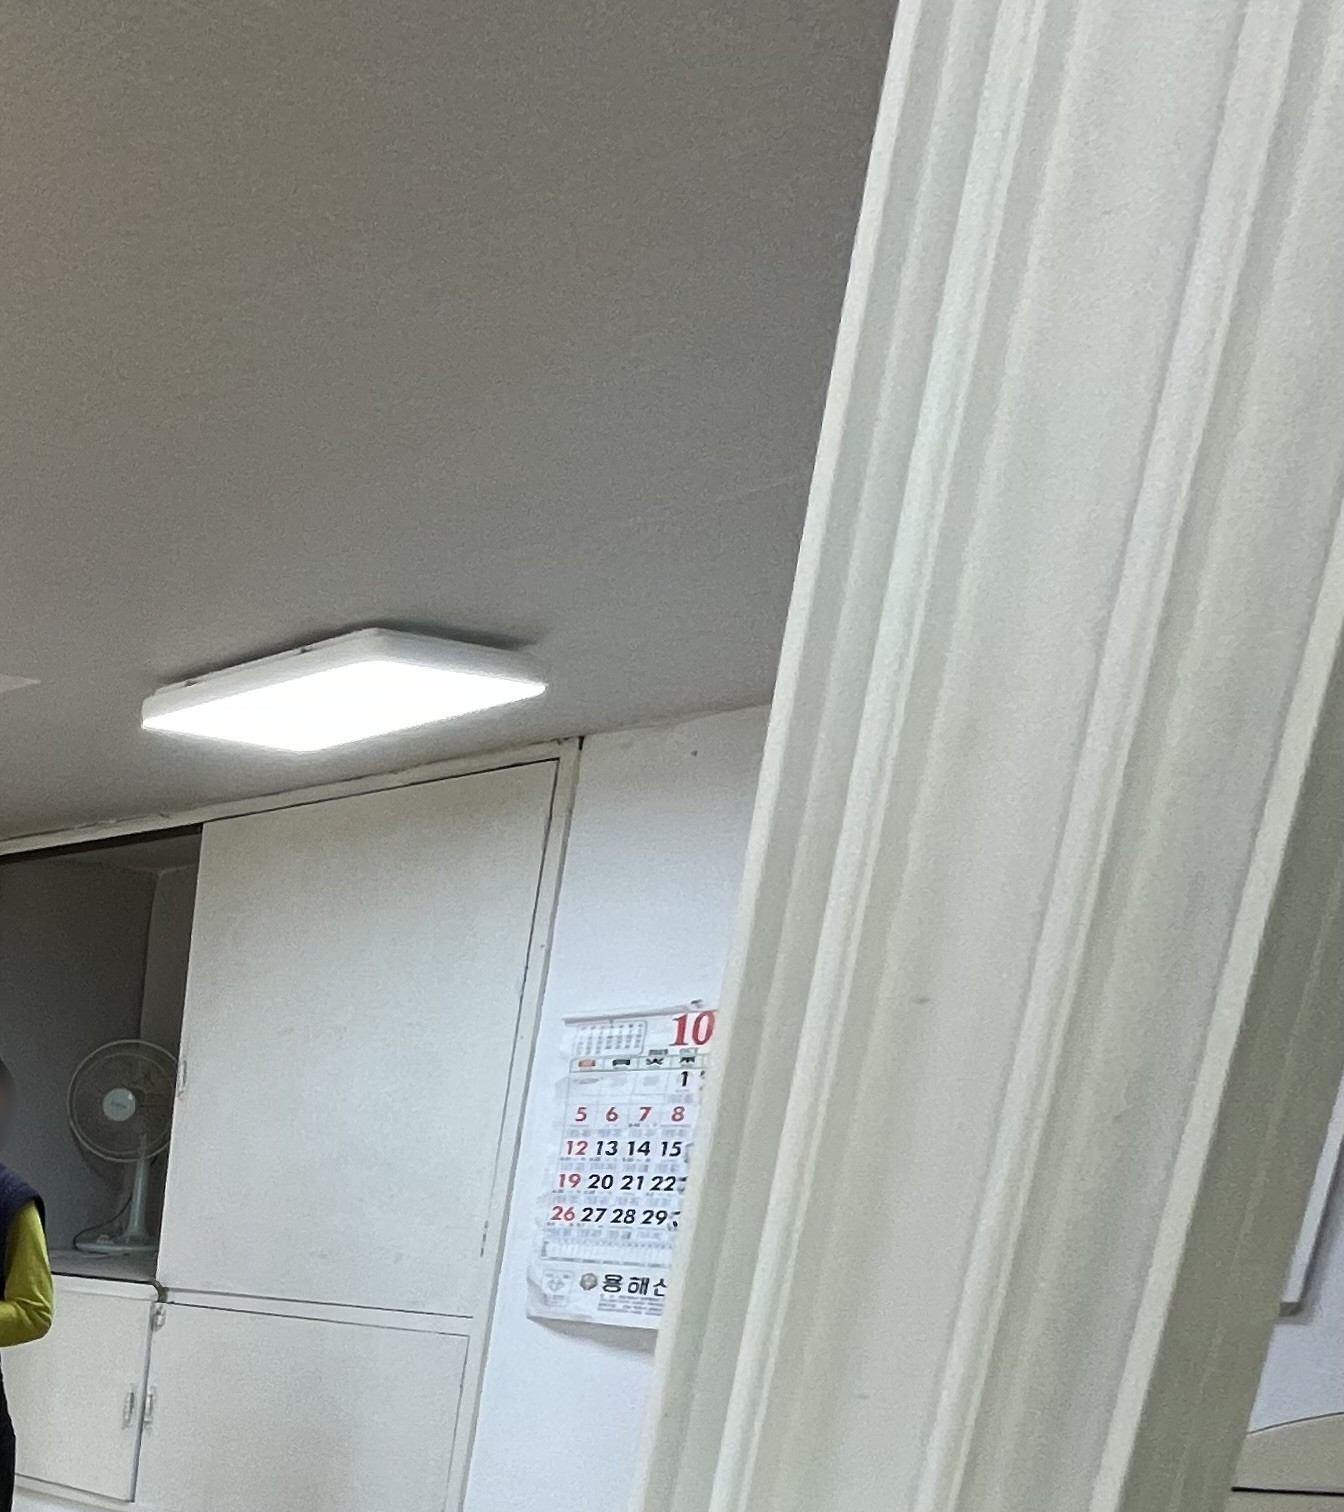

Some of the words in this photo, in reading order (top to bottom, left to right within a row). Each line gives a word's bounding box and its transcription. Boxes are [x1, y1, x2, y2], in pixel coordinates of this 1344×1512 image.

[669, 1010, 716, 1047] 10
[680, 1070, 688, 1087] 1
[575, 1106, 587, 1122] 5
[605, 1106, 619, 1122] 6
[639, 1106, 653, 1122] 7
[671, 1106, 685, 1122] 8
[567, 1140, 589, 1156] 12
[596, 1140, 618, 1156] 13
[628, 1140, 651, 1156] 14
[661, 1141, 683, 1157] 15
[559, 1173, 581, 1188] 19
[587, 1174, 614, 1190] 20
[620, 1175, 644, 1191] 21
[649, 1175, 677, 1191] 22
[550, 1205, 576, 1222] 26
[580, 1207, 608, 1222] 27
[610, 1208, 636, 1224] 28
[640, 1209, 668, 1225] 29
